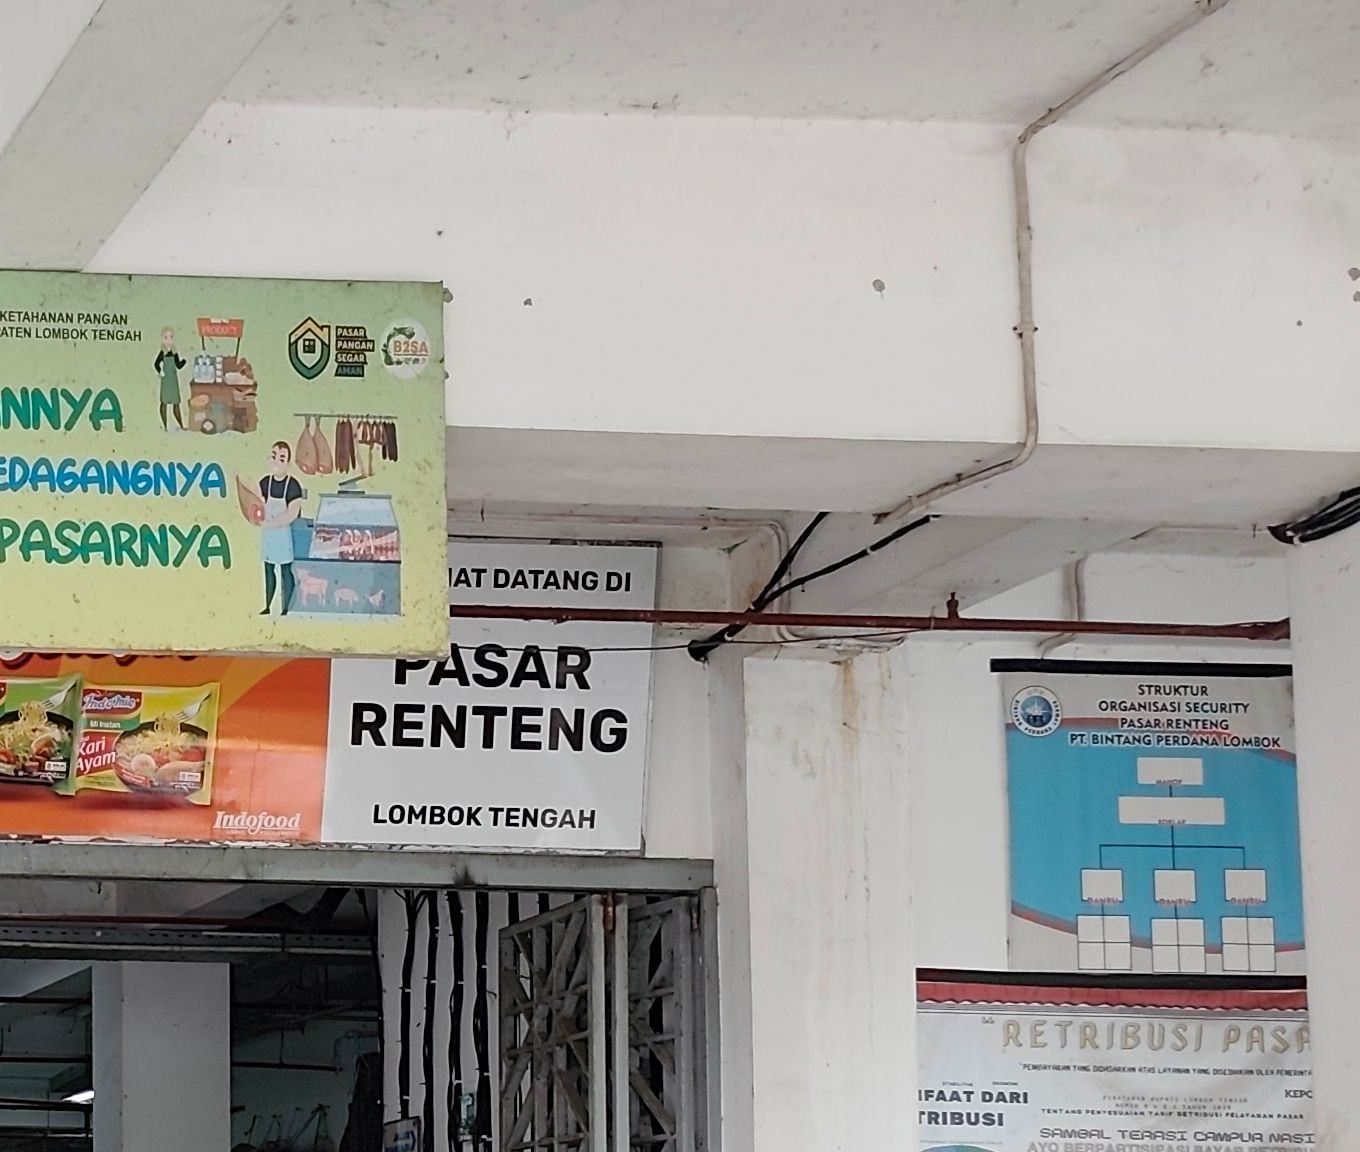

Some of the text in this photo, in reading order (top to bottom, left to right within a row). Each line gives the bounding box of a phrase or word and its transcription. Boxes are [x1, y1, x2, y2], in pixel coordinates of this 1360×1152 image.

[0, 310, 76, 325] KETAHANAN
[78, 312, 129, 326] PANGAN
[36, 327, 86, 341] LOMBOK
[89, 328, 142, 342] TENGAH
[337, 328, 365, 337] PASAR
[337, 341, 373, 350] PANGAN
[393, 340, 428, 354] B2SA
[336, 354, 365, 363] SEGAR
[493, 569, 598, 592] DATANG
[606, 572, 632, 592] DI
[394, 643, 591, 690] PASAR
[1138, 685, 1208, 696] STRUKTUR
[81, 692, 136, 710] Indomie
[1098, 701, 1250, 714] ORGANISASI SECURITY
[350, 702, 628, 752] RENTENG
[1121, 717, 1229, 731] PASAR RENTENG
[79, 736, 106, 756] Kari
[1070, 734, 1280, 748] PT. BINTANG PERDANA LOMBOK
[77, 751, 116, 774] Ayam
[213, 811, 301, 835] Indofood
[373, 804, 596, 830] LOMBOK TENGAH
[1002, 1018, 1204, 1052] RETRIBUSI
[981, 1091, 1028, 1104] DARI
[1040, 1128, 1315, 1144] SAMBAL TERASI CAMPUR NASI
